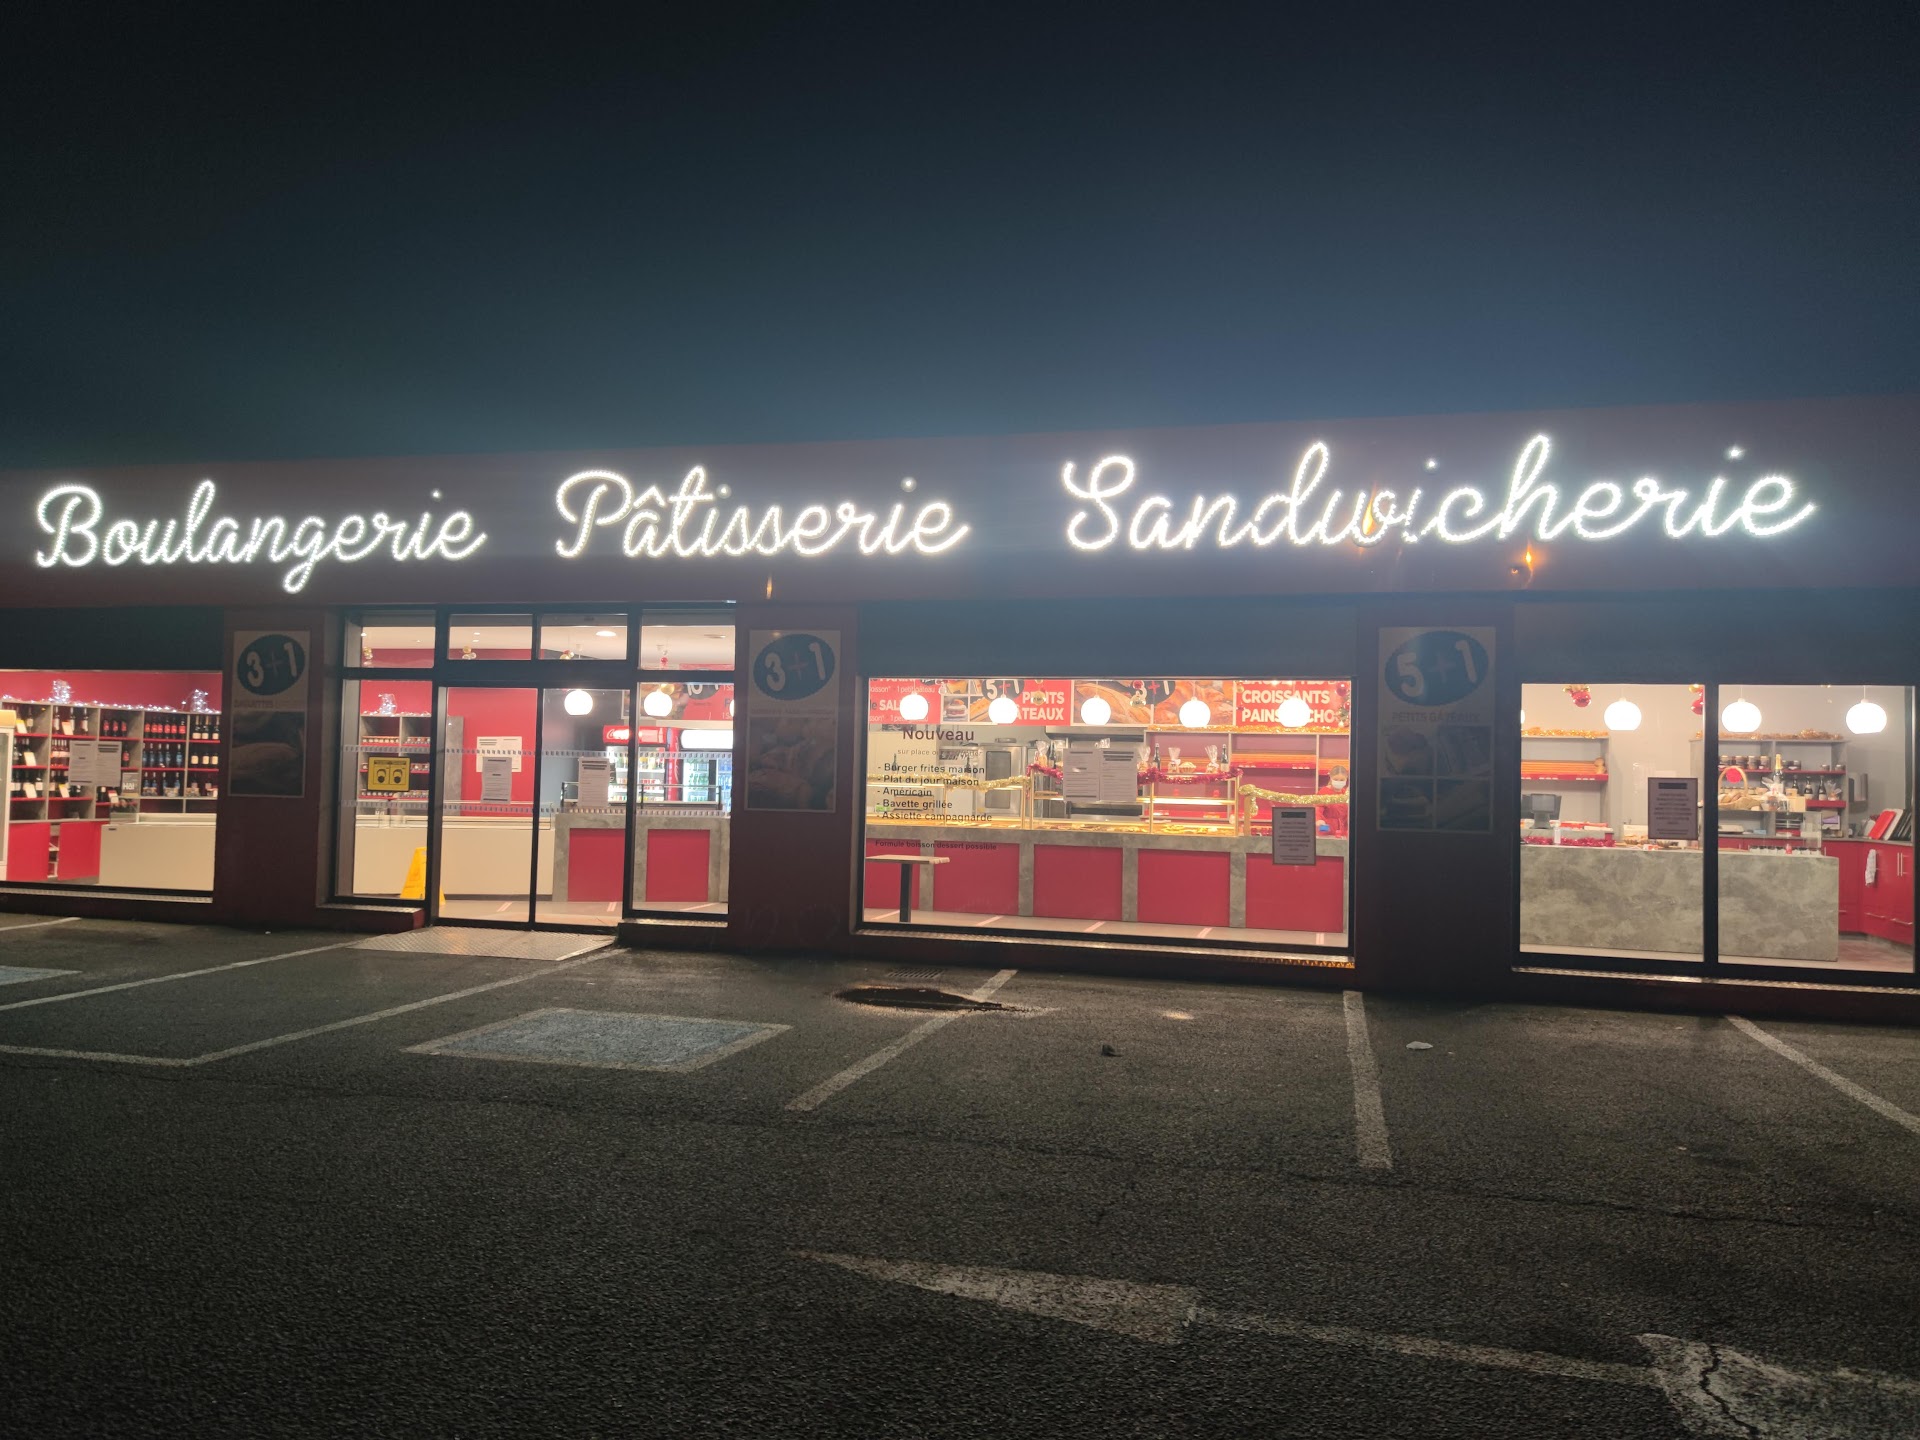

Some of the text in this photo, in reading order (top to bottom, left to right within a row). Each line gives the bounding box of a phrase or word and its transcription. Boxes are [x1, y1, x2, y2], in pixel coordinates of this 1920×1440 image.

[37, 434, 1817, 593] Boulangerie Pâtisserie Sandwicherie
[246, 641, 298, 688] 3+1
[764, 641, 826, 692] 3+1
[1397, 640, 1478, 698] 5+1
[1022, 691, 1065, 705] PITS
[1241, 690, 1331, 704] CROISSANTS
[1012, 705, 1064, 720] ÂTEAUX
[903, 728, 975, 741] Nouveau
[911, 748, 930, 756] place
[884, 763, 917, 774] Burger
[920, 763, 945, 773] frites
[948, 764, 985, 774] maison
[883, 775, 902, 783] Plat
[905, 775, 917, 784] du
[920, 776, 940, 786] jour
[942, 777, 979, 786] maison
[882, 787, 932, 797] Américain
[882, 799, 919, 809] Bavette
[922, 800, 953, 811] grillée
[882, 811, 922, 821] Assiette
[924, 813, 993, 823] campagnarde
[875, 840, 997, 851] Formule boisson dessert possible
